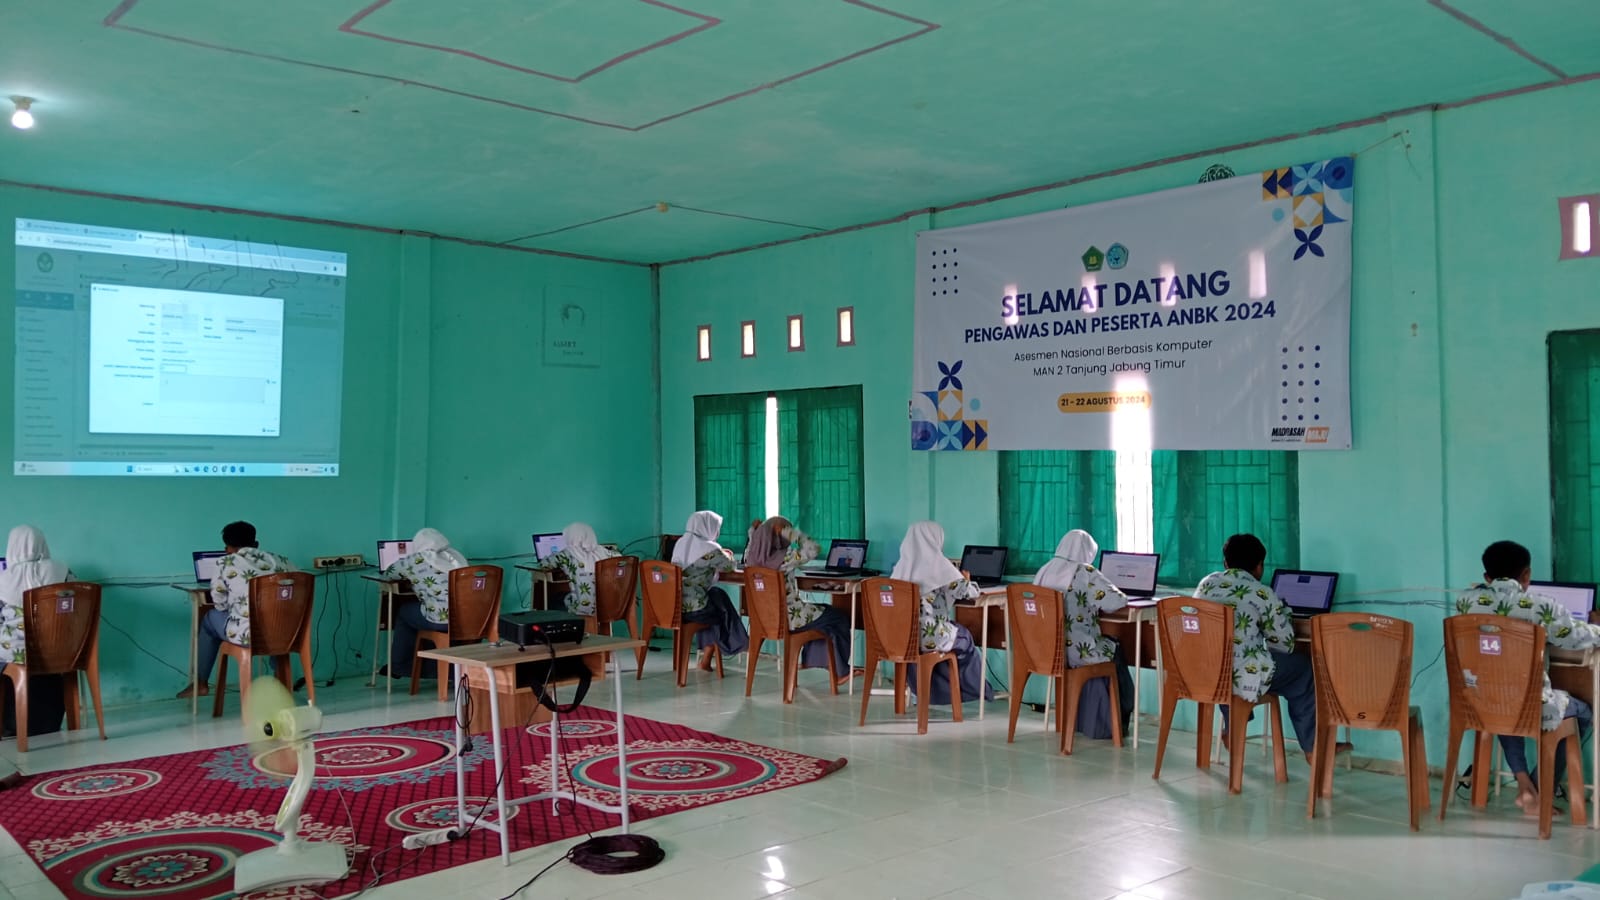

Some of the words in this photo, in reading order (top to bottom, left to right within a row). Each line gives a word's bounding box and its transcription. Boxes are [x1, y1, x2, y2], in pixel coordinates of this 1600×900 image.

[1001, 284, 1107, 318] SELAMAT
[1114, 270, 1230, 306] DATANG
[965, 322, 1049, 343] PENGAWAS
[1053, 318, 1087, 336] DAN
[1091, 311, 1163, 333] PESERTA
[1166, 306, 1219, 326] ANBK
[1225, 300, 1276, 321] 2024
[1014, 350, 1058, 362] Asesmen
[1061, 346, 1105, 359] Nasional
[1107, 342, 1153, 355] Berbasis
[1156, 339, 1213, 353] Komputer
[1033, 366, 1055, 377] MAN
[1057, 366, 1063, 375] 2
[1066, 363, 1107, 376] Tanjung
[1109, 361, 1151, 373] Jabung
[1154, 358, 1186, 369] Timur
[1061, 398, 1068, 406] 21
[1076, 398, 1085, 406] 22
[1086, 397, 1124, 406] AGUSTUS
[476, 580, 482, 588] 7
[281, 589, 288, 598] 6
[882, 595, 894, 603] 11
[61, 601, 69, 610] 5
[1025, 603, 1037, 611] 12
[1184, 619, 1199, 630] 13
[1482, 639, 1500, 651] 14
